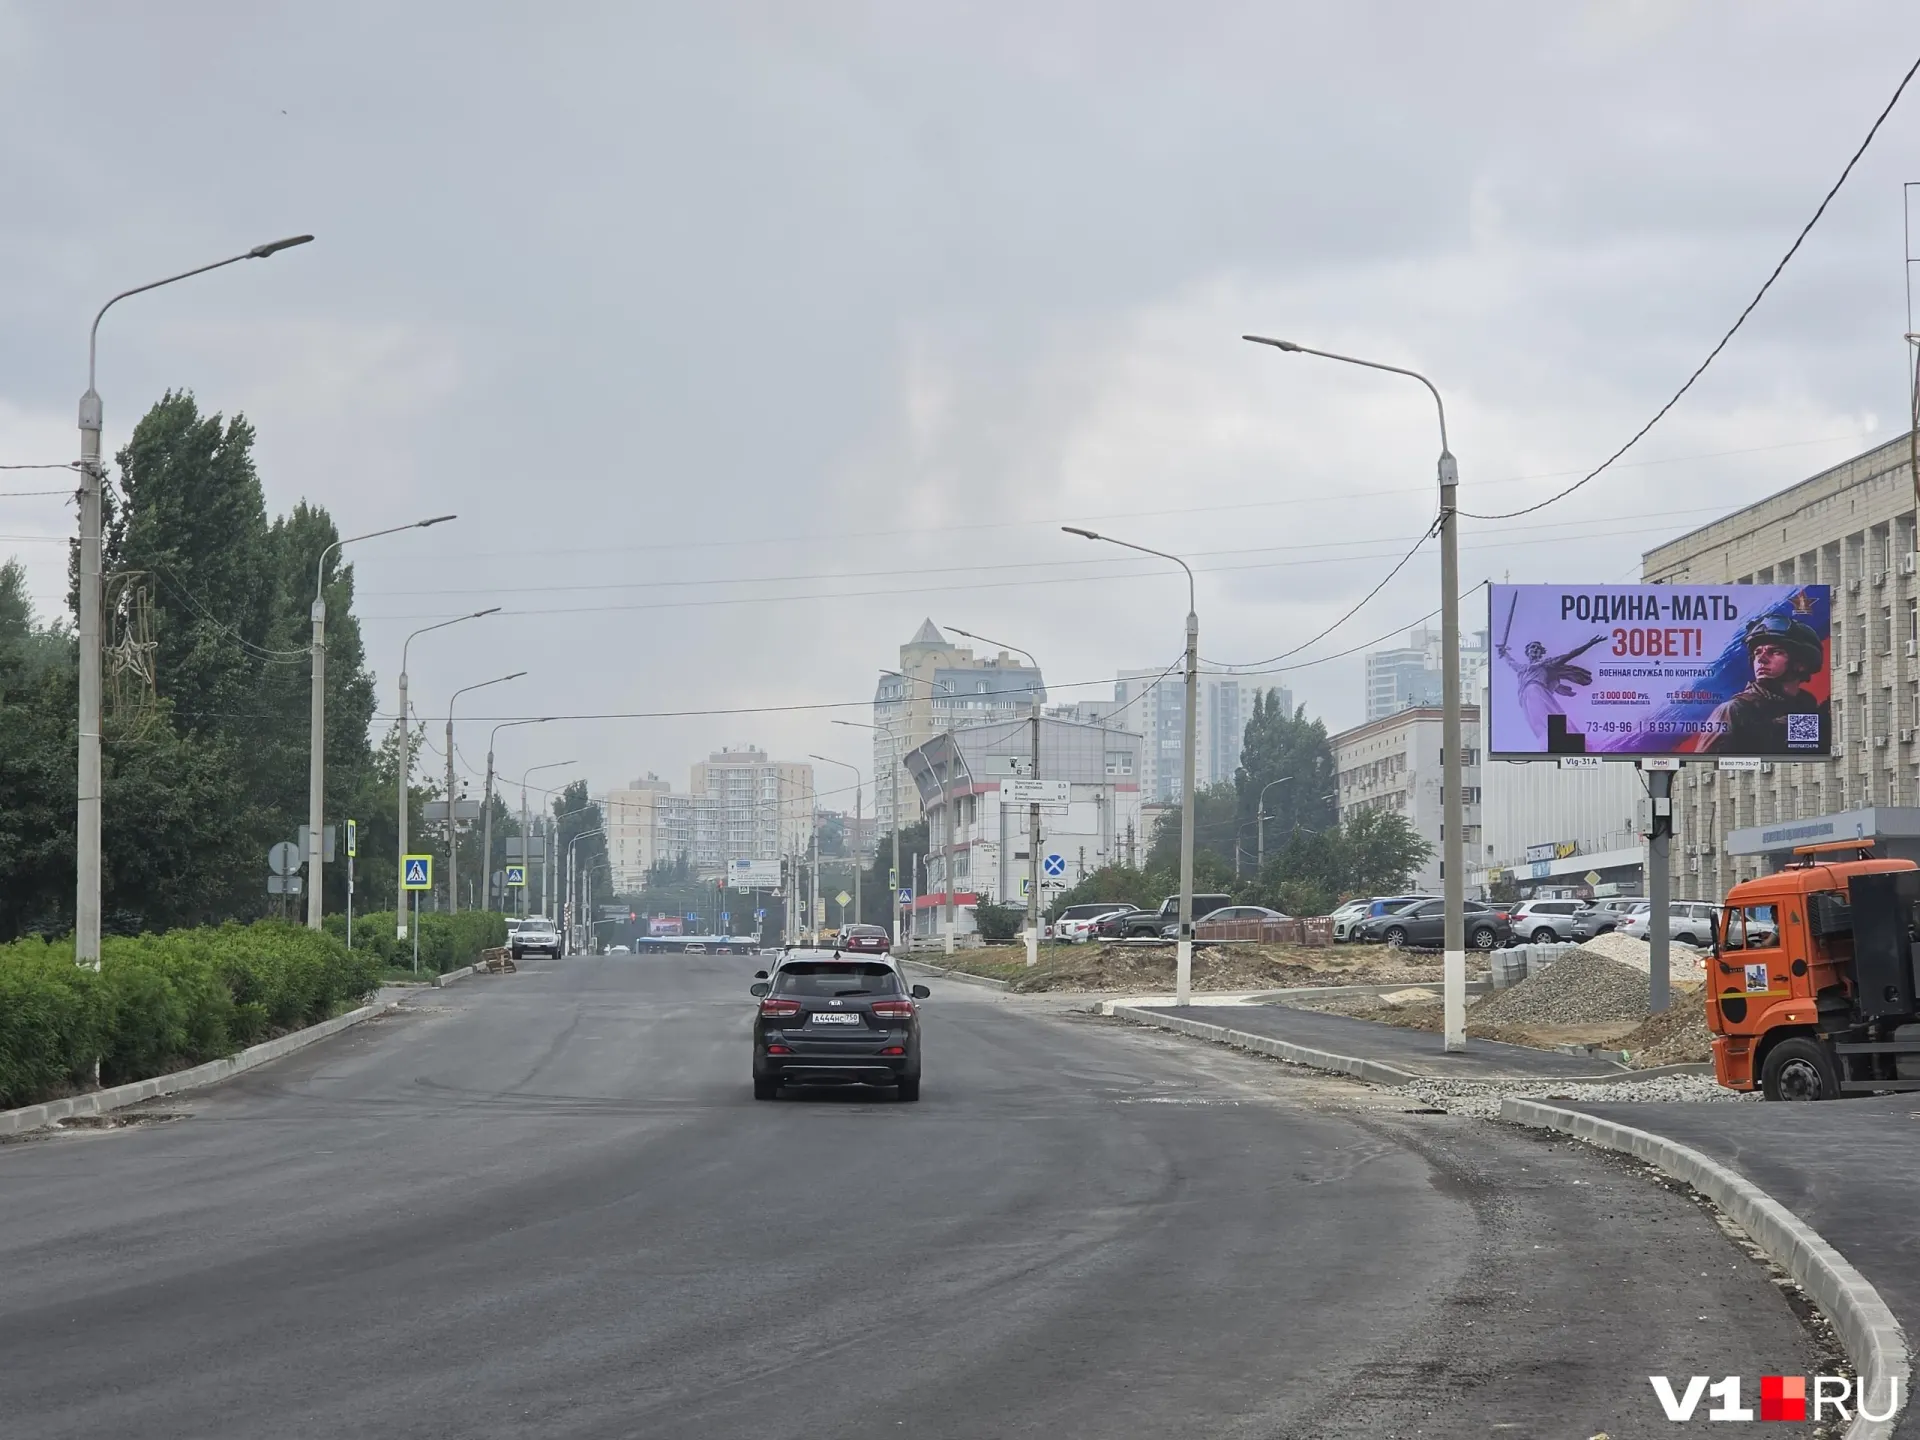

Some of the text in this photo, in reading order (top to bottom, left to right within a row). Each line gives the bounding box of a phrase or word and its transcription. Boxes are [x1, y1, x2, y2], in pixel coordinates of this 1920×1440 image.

[1561, 595, 1738, 623] РОДИНА-МАТЬ
[1612, 628, 1702, 657] ЗОВЕТ!
[1599, 669, 1716, 677] ВОЕННАЯ СЛУЖБА ПО КОНТРАКТУ
[1600, 691, 1605, 699] 3
[1606, 691, 1620, 699] 000
[1622, 691, 1636, 699] 000
[1586, 722, 1728, 732] 73-49-96 8 937 700 53 73
[1566, 758, 1590, 766] Vlg-31
